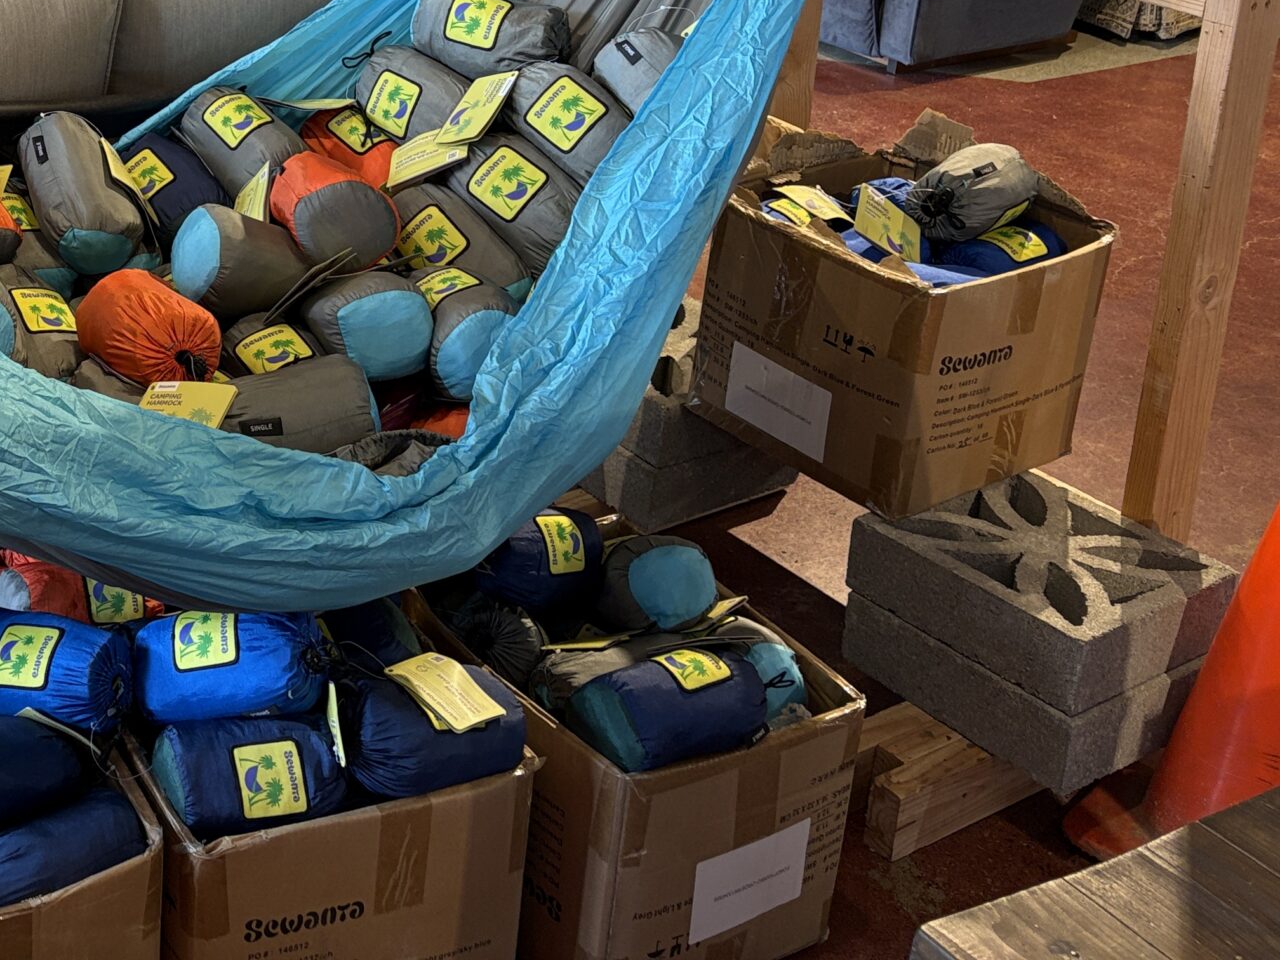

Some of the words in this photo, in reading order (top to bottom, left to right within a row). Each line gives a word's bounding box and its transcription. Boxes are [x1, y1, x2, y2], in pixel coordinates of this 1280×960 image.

[534, 84, 567, 119] Sewanta
[474, 154, 507, 187] Sewanta
[938, 344, 1014, 376] Sewanta
[250, 423, 273, 432] SINGLE
[283, 749, 300, 803] Sewanta
[243, 900, 365, 943] Sewanta
[652, 901, 676, 918] Light
